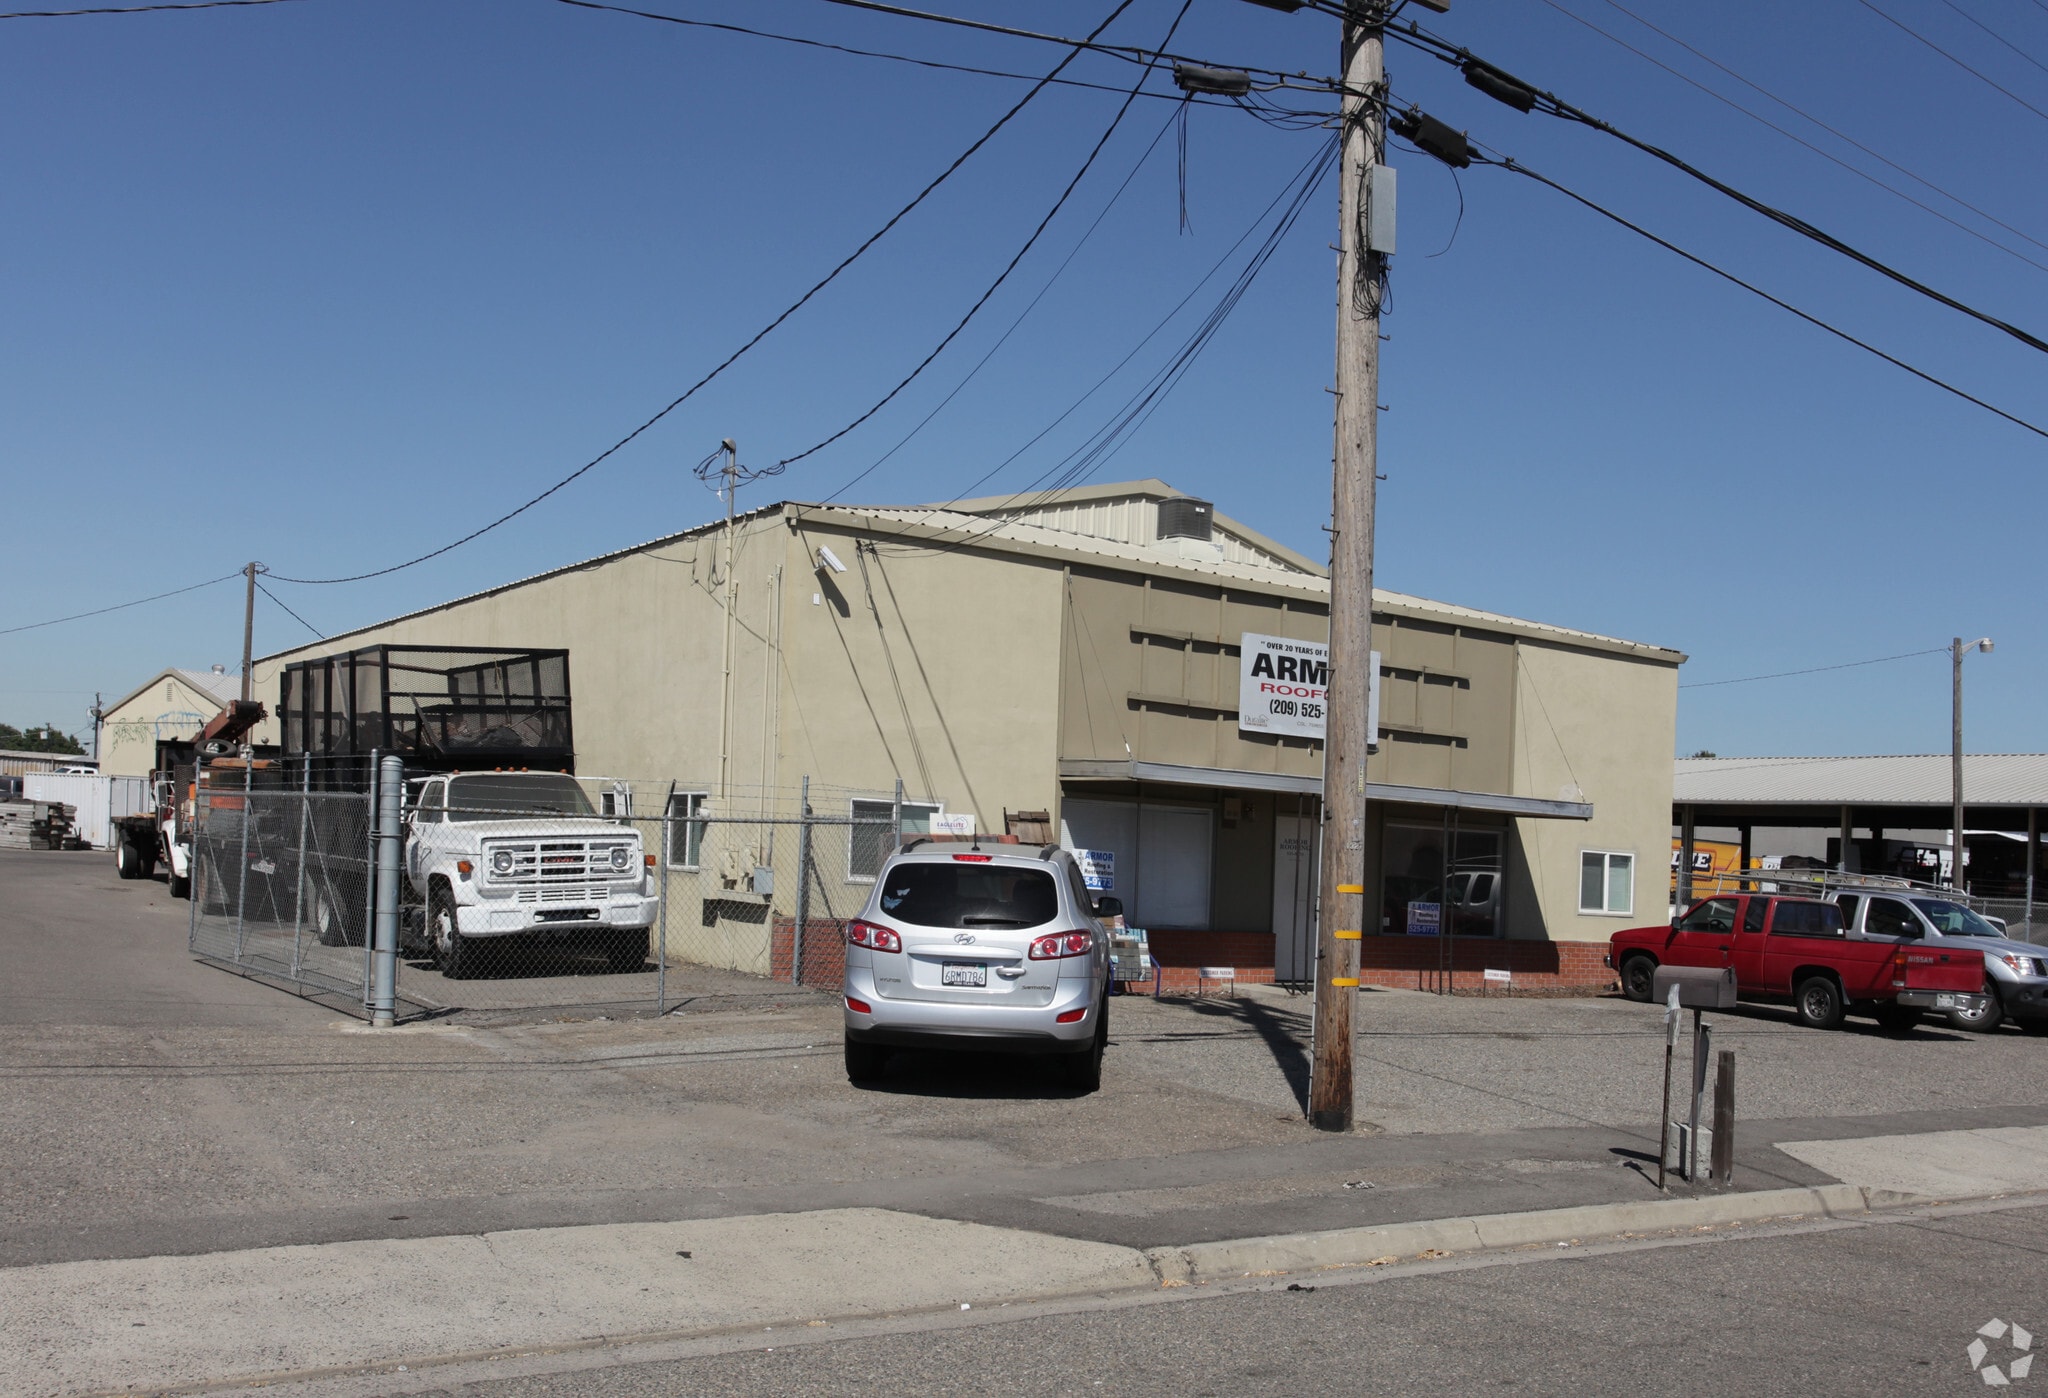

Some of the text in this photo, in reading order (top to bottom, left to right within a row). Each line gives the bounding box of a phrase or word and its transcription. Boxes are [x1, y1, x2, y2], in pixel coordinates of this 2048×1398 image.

[1266, 642, 1284, 651] OVER
[1284, 644, 1294, 652] 20
[1294, 646, 1314, 655] YEARS
[1251, 652, 1328, 686] ARM
[1269, 699, 1325, 719] (209) 525-
[1085, 850, 1114, 862] ARMOR
[1085, 876, 1113, 887] 5-9773
[1418, 903, 1439, 911] ARMOR
[1907, 955, 1934, 964] NISSAN
[945, 970, 984, 983] 6RMD786
